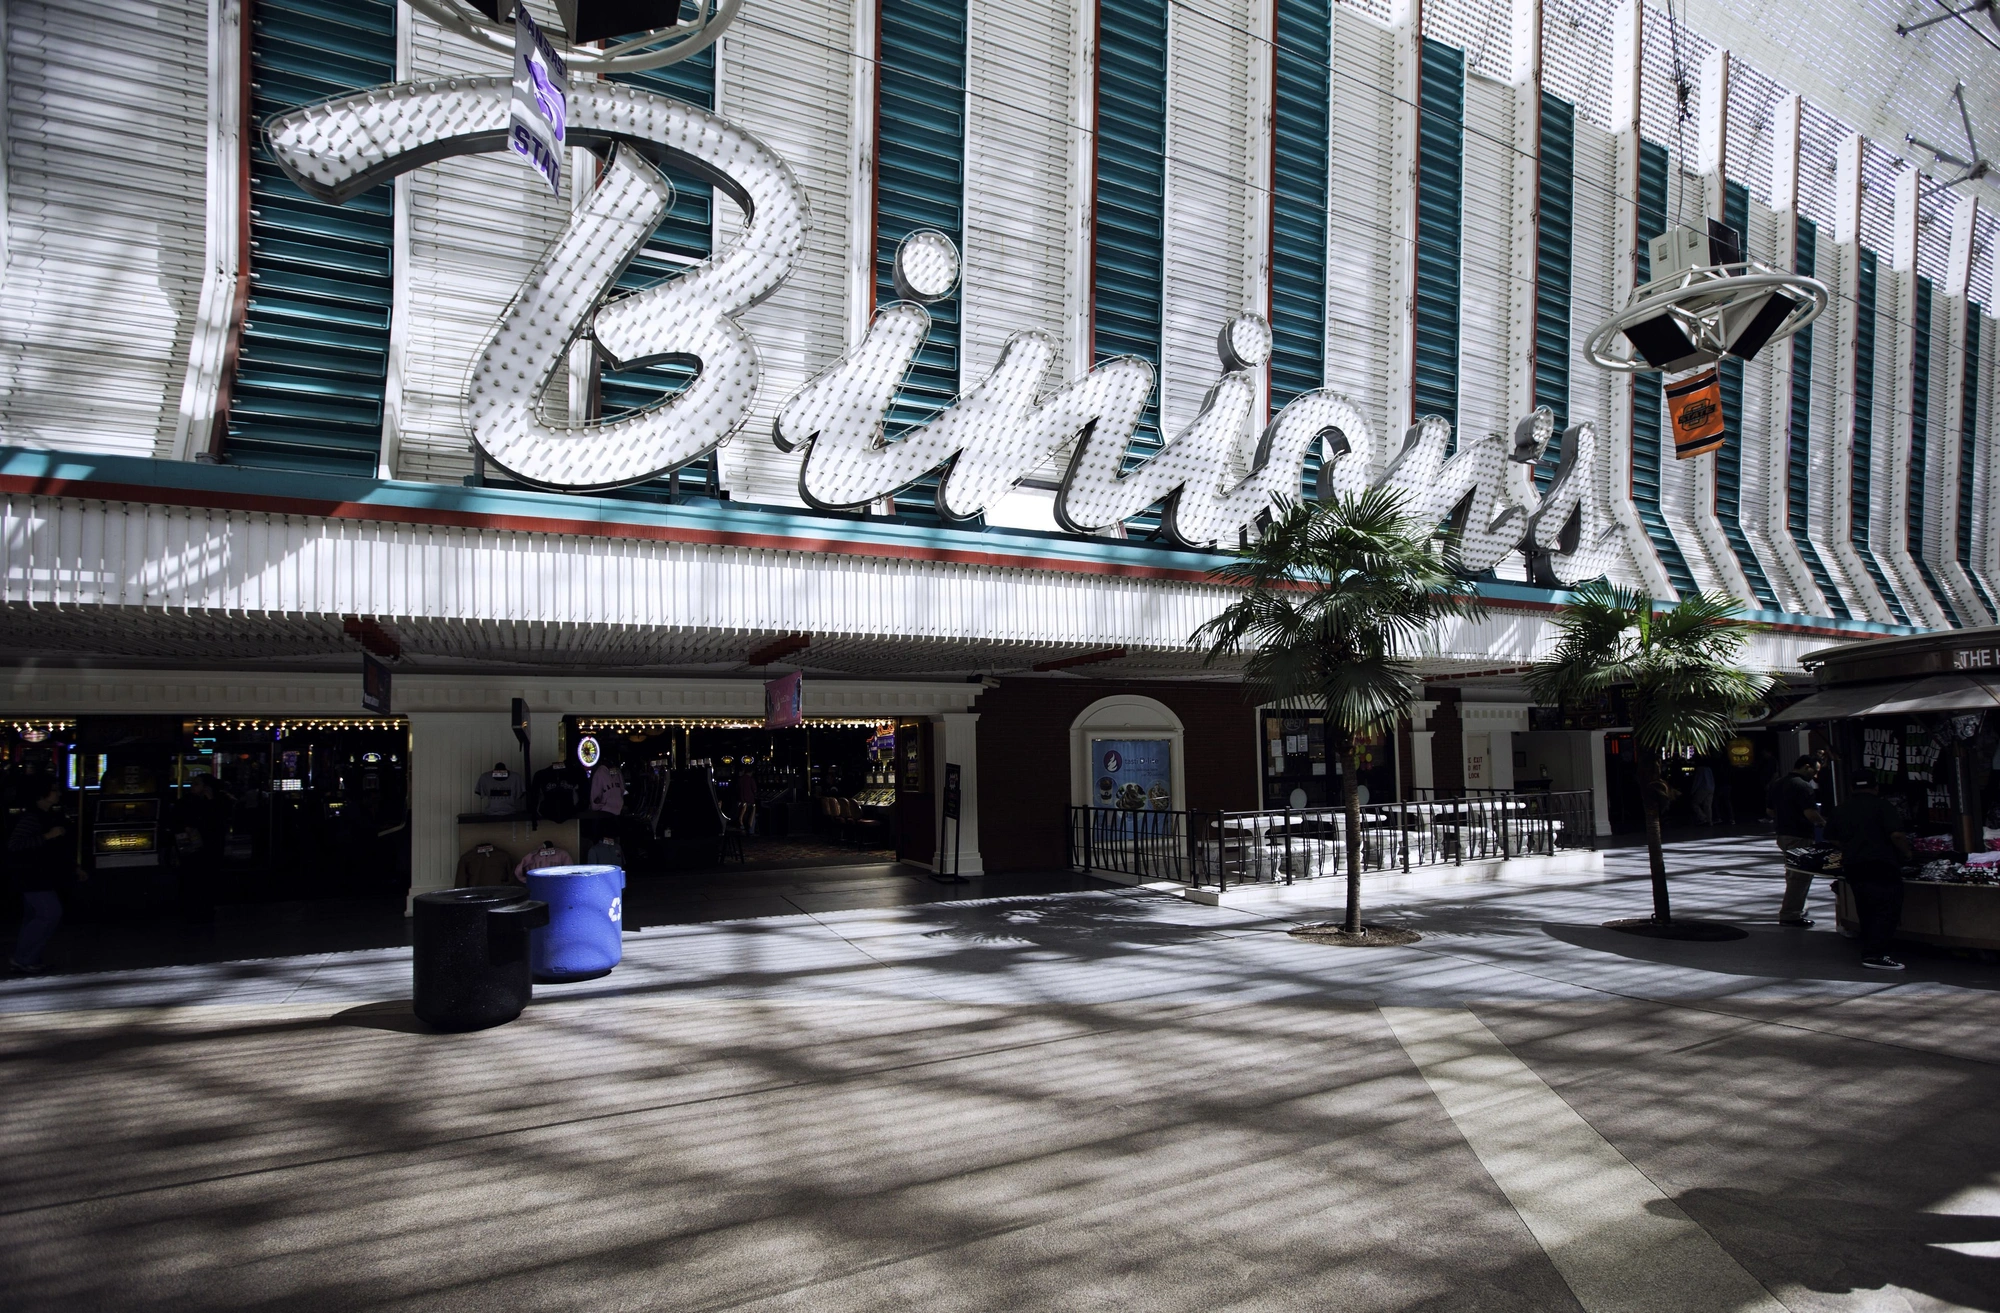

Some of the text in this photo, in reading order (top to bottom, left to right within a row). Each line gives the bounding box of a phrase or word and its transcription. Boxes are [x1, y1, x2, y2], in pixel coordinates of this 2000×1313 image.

[262, 72, 1630, 588] Binion's
[1680, 404, 1714, 423] STATE
[1959, 649, 1991, 668] THE
[1864, 741, 1900, 758] ASK ME
[1863, 754, 1900, 772] FOR
